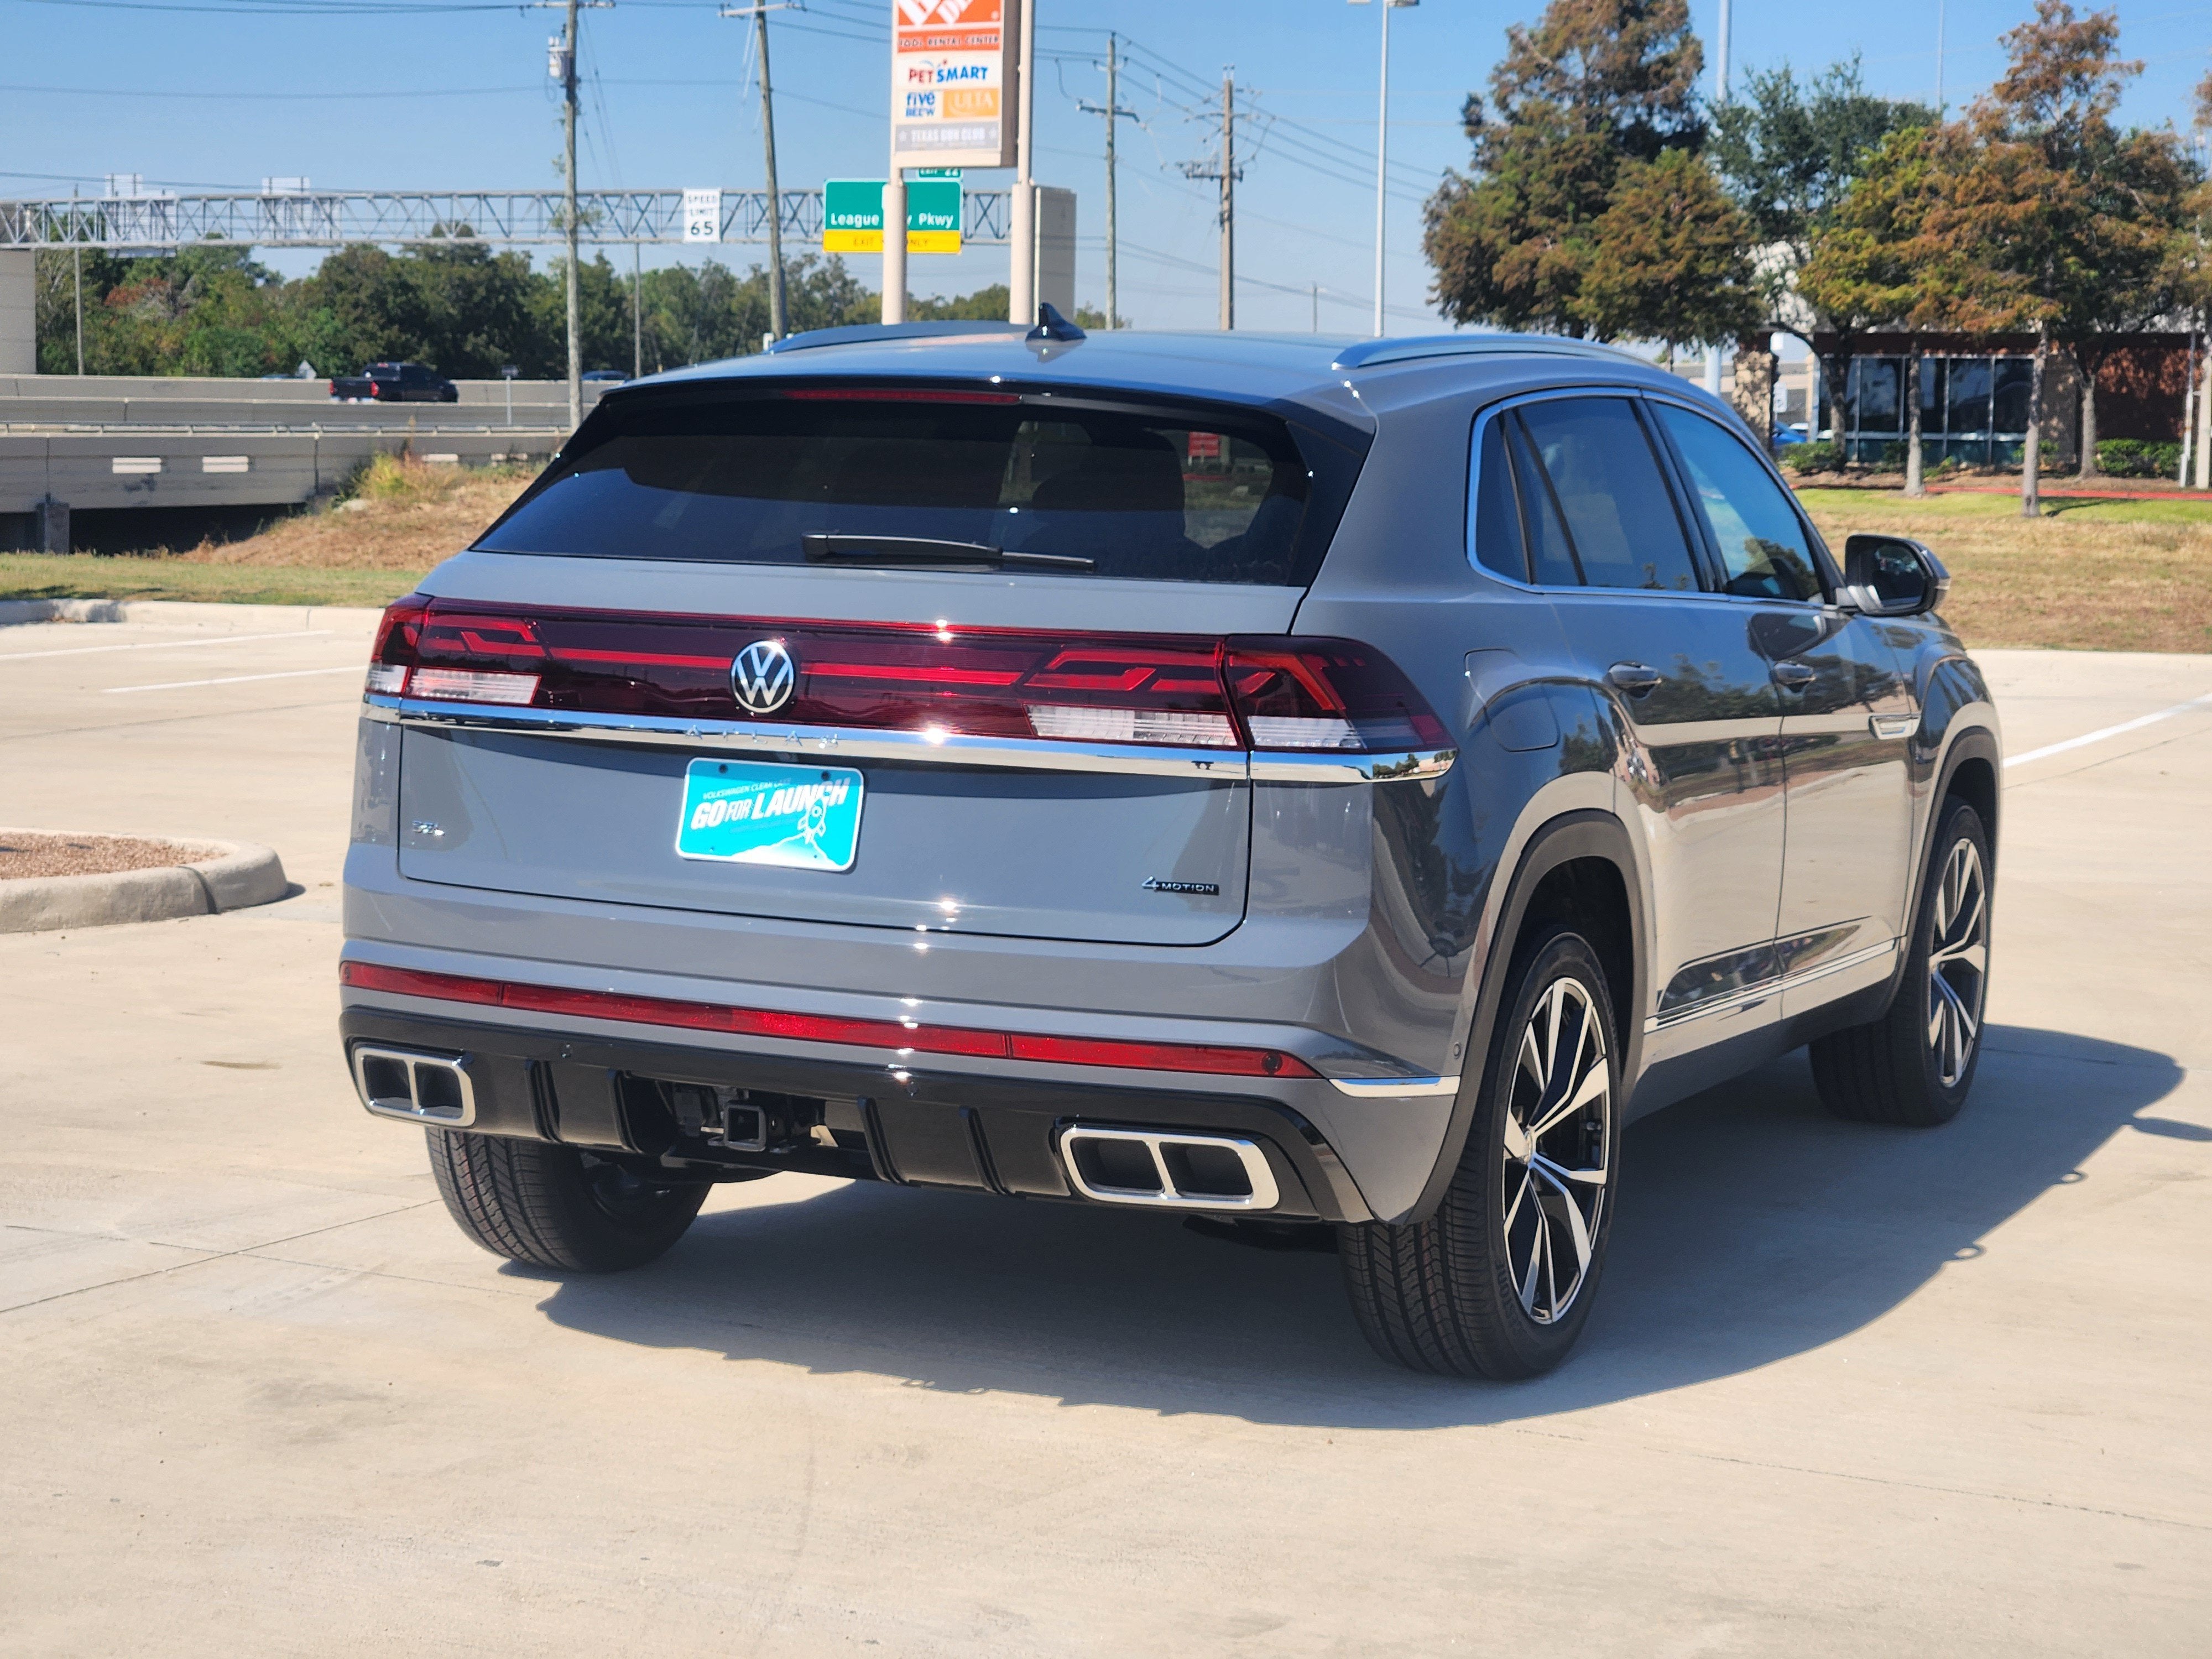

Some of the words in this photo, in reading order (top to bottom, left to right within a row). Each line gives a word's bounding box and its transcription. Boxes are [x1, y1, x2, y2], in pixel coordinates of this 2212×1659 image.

[928, 36, 961, 45] RENTAL
[966, 34, 998, 43] CENTER
[906, 92, 935, 105] five
[688, 195, 717, 204] SPEED
[690, 208, 714, 217] LIMIT
[831, 212, 880, 228] League
[918, 212, 954, 229] Pkwy
[691, 221, 713, 236] 65
[691, 799, 728, 830] GO
[724, 799, 753, 823] FOR
[750, 776, 851, 820] LAUNCH
